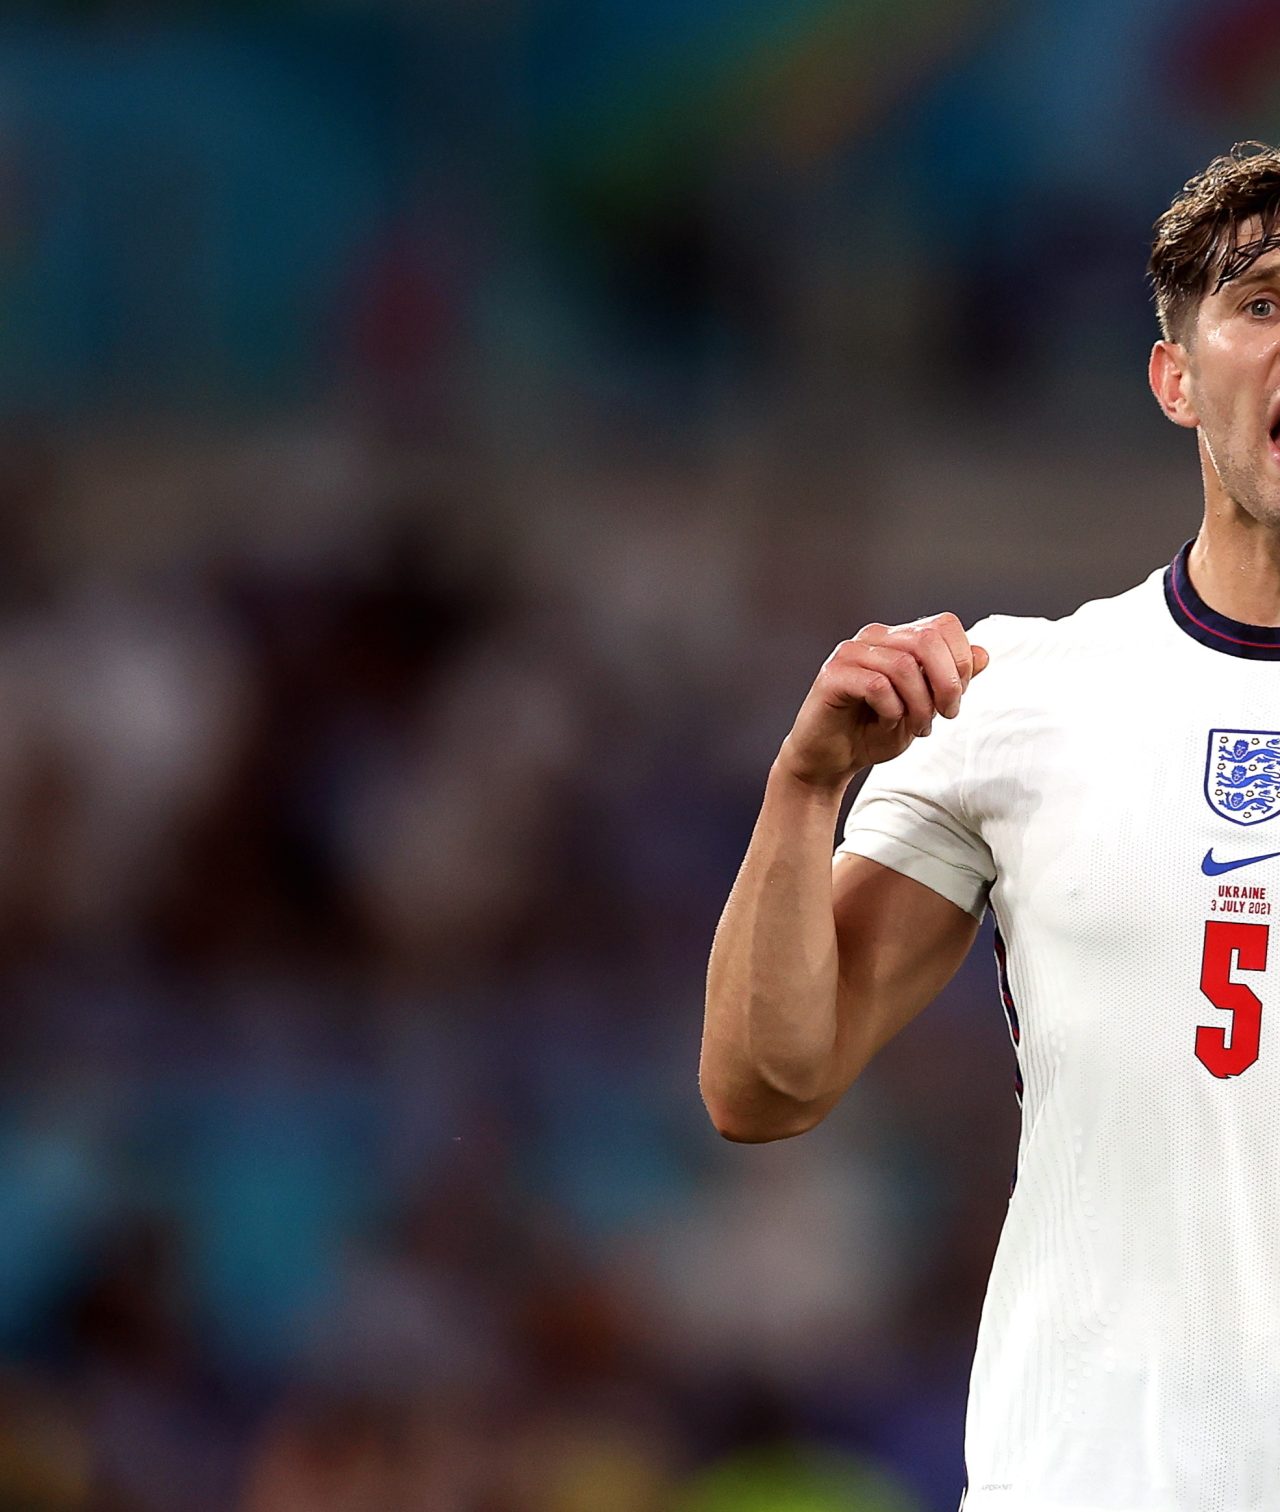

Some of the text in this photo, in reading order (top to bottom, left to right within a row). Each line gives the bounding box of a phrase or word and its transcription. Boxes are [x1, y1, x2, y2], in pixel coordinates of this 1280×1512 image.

[1218, 885, 1266, 900] UKRAINE
[1210, 899, 1271, 915] 3 JULY 2021
[1194, 920, 1270, 1079] 5
